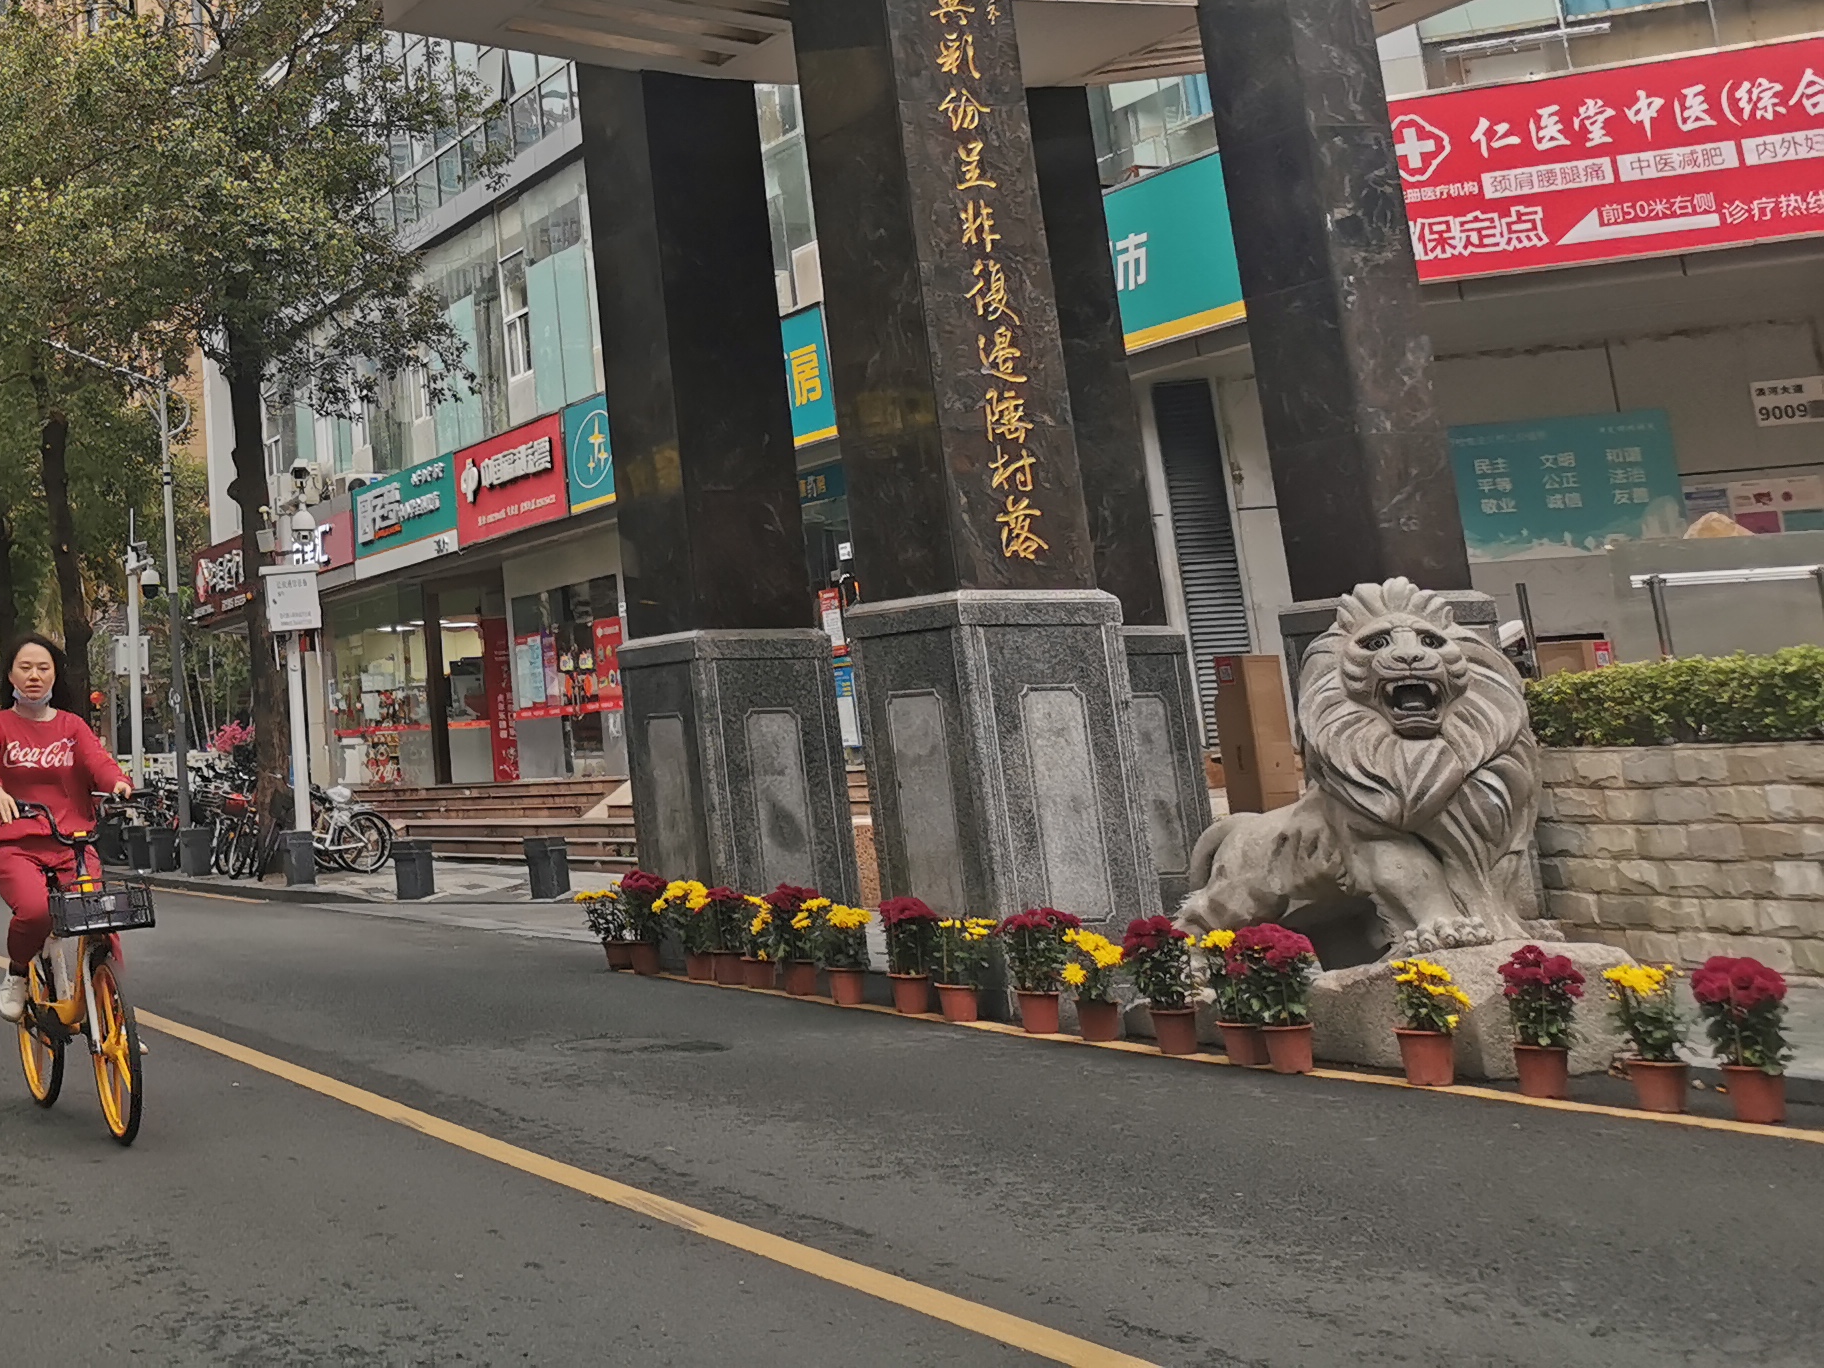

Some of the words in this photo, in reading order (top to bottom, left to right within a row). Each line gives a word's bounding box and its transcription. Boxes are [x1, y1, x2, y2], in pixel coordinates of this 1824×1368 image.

[1489, 162, 1607, 193] 颈肩腰腿痛
[1630, 146, 1726, 176] 中医减肥
[1755, 133, 1824, 161] 内外妇
[1601, 192, 1716, 224] 前50米右侧
[1409, 206, 1550, 261] 保定点
[1108, 232, 1148, 291] 市
[784, 343, 823, 410] 房
[1758, 403, 1808, 421] 9009
[1474, 458, 1509, 474] 民主
[1539, 452, 1576, 469] 文明
[1477, 477, 1513, 493] 平等
[1542, 472, 1580, 489] 公正
[1608, 468, 1646, 484] 法治
[1545, 493, 1583, 509] 诚信
